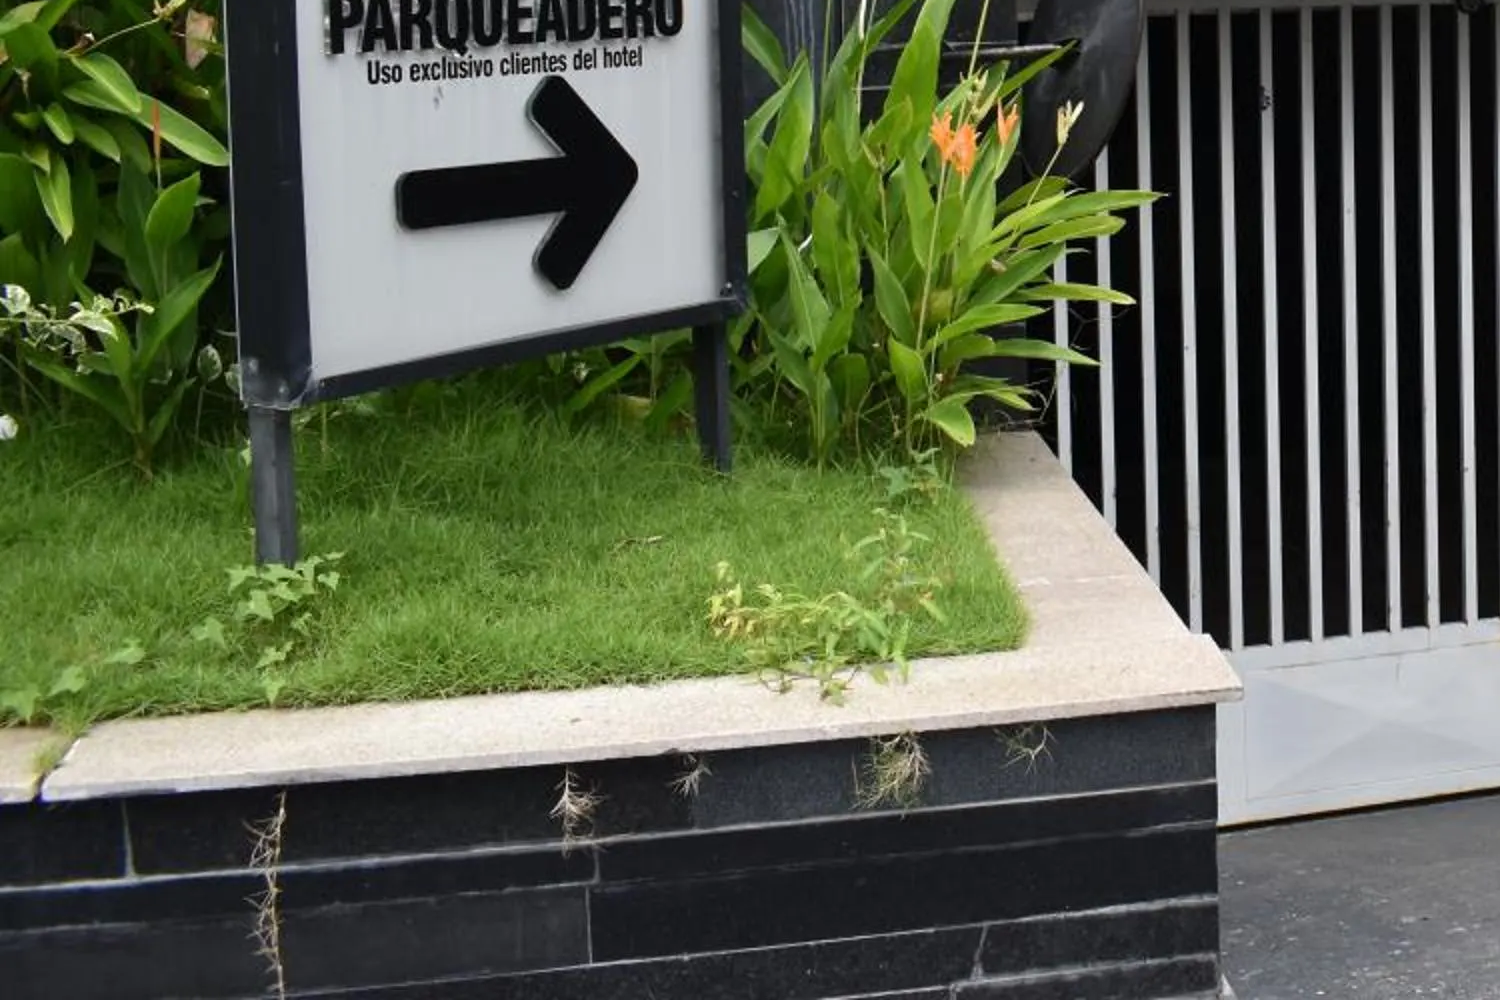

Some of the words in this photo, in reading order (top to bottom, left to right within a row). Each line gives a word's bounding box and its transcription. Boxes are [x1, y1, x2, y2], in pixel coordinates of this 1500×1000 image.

[367, 59, 402, 85] Uso
[409, 56, 493, 82] exclusivo
[500, 51, 567, 76] clientes
[573, 49, 596, 70] del
[603, 46, 643, 68] hotel
